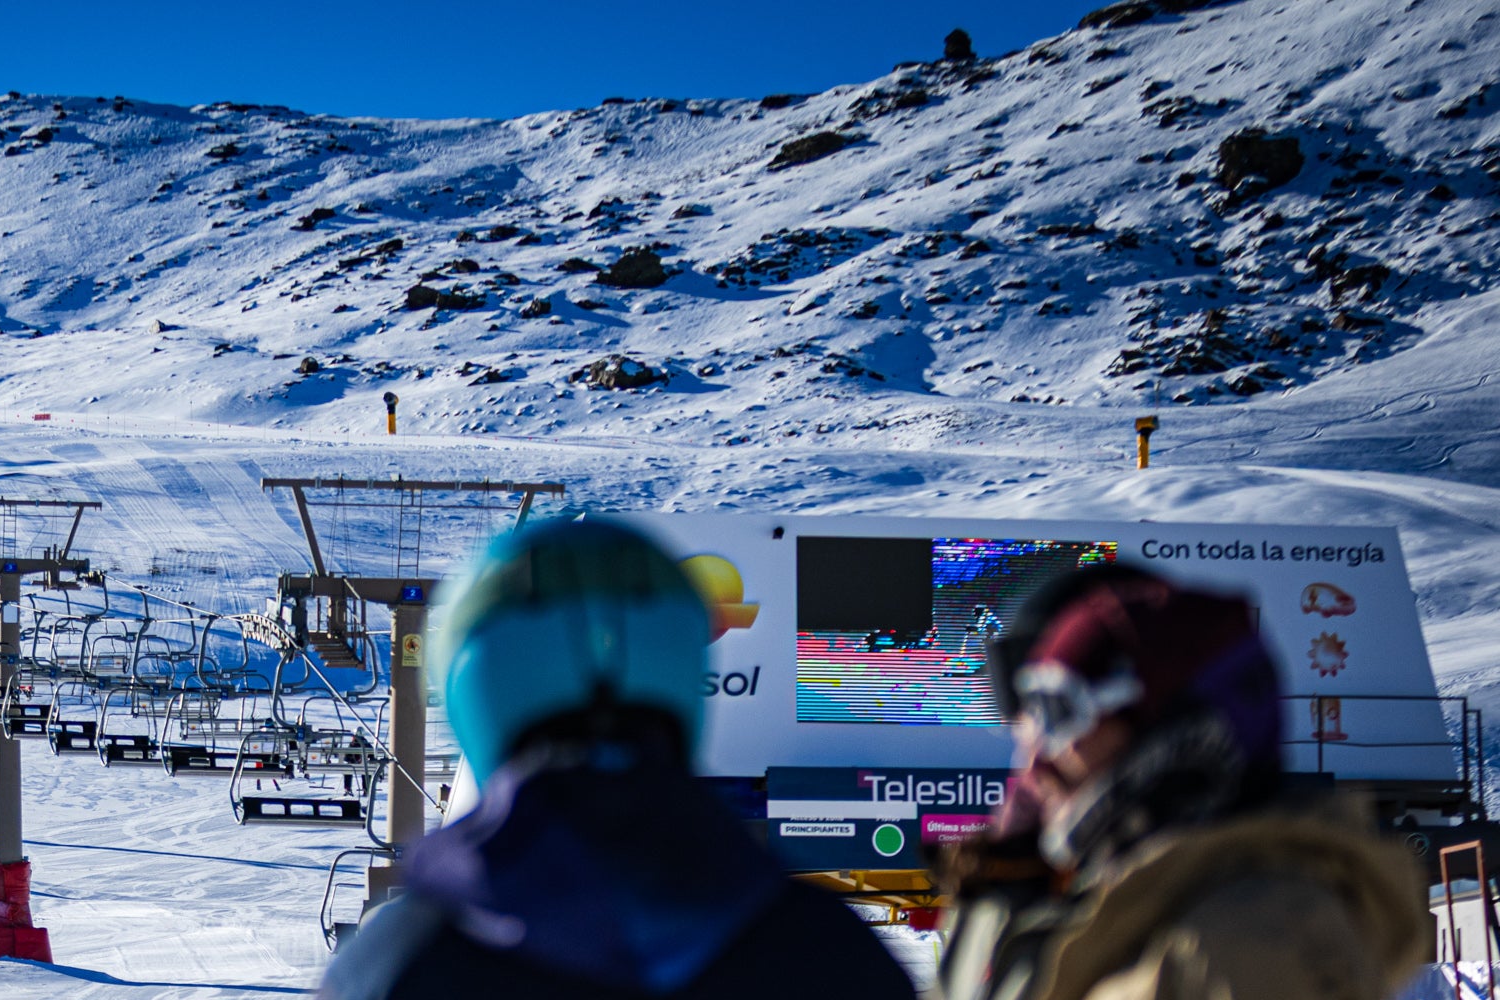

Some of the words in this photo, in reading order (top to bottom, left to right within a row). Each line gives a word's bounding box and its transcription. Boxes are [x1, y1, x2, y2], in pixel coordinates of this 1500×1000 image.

[1141, 540, 1190, 560] Con
[1196, 540, 1255, 561] toda
[1261, 540, 1285, 562] la
[1290, 542, 1386, 567] energía
[699, 666, 761, 697] sol
[863, 774, 1005, 806] Telesilla
[785, 825, 850, 834] PRINCIPIANTES
[926, 820, 959, 832] Última
